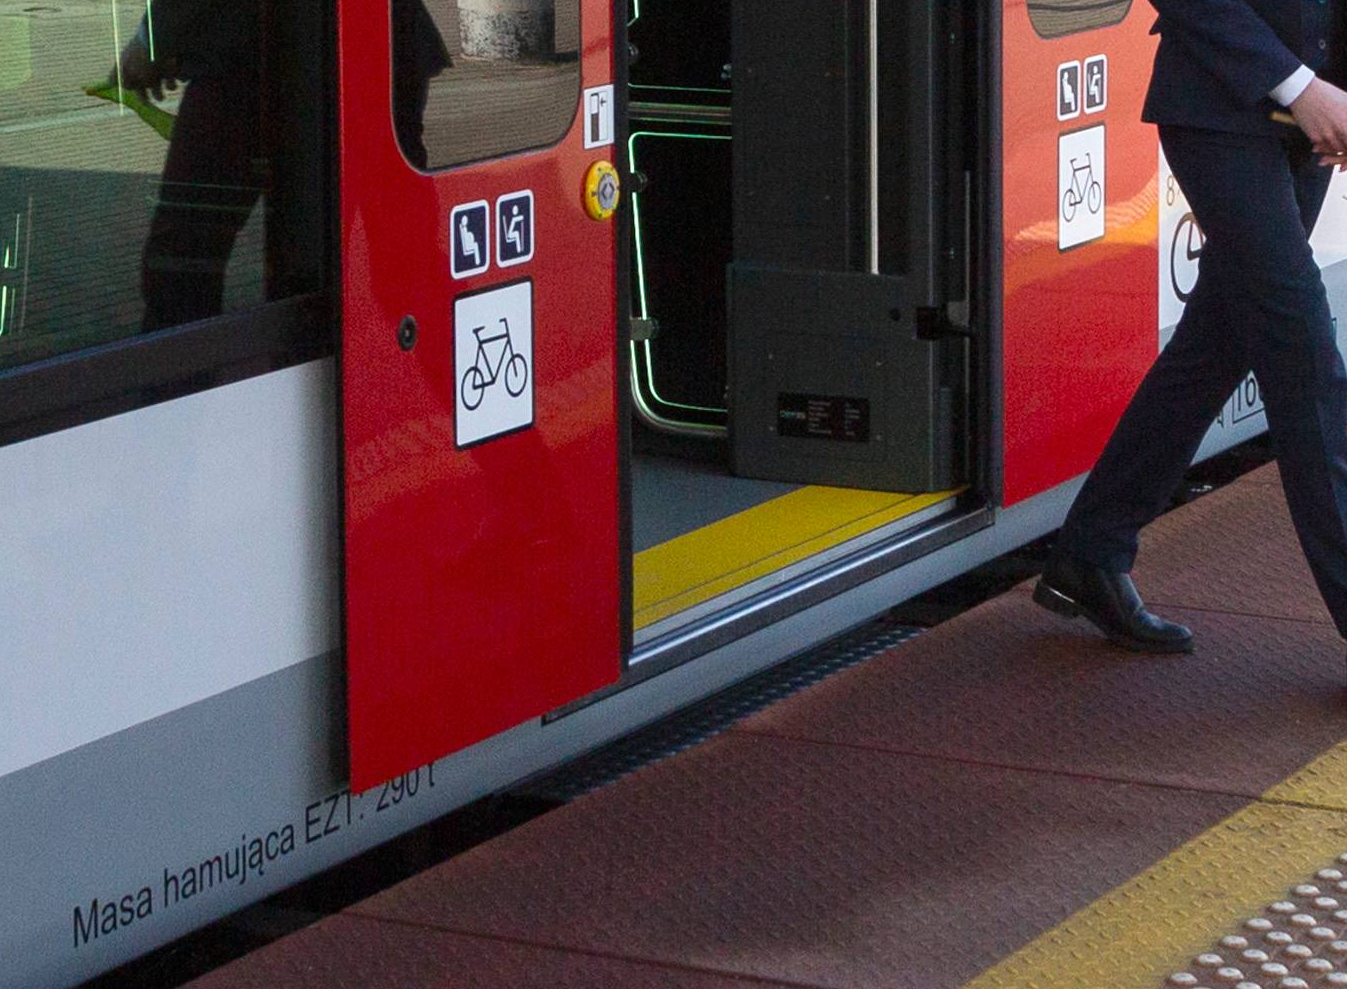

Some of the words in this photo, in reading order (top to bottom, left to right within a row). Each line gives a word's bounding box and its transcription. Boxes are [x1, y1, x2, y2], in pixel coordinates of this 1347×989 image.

[73, 886, 153, 949] Masa
[163, 823, 295, 909] hamująca
[304, 788, 364, 844] EZT:
[376, 767, 420, 813] 290
